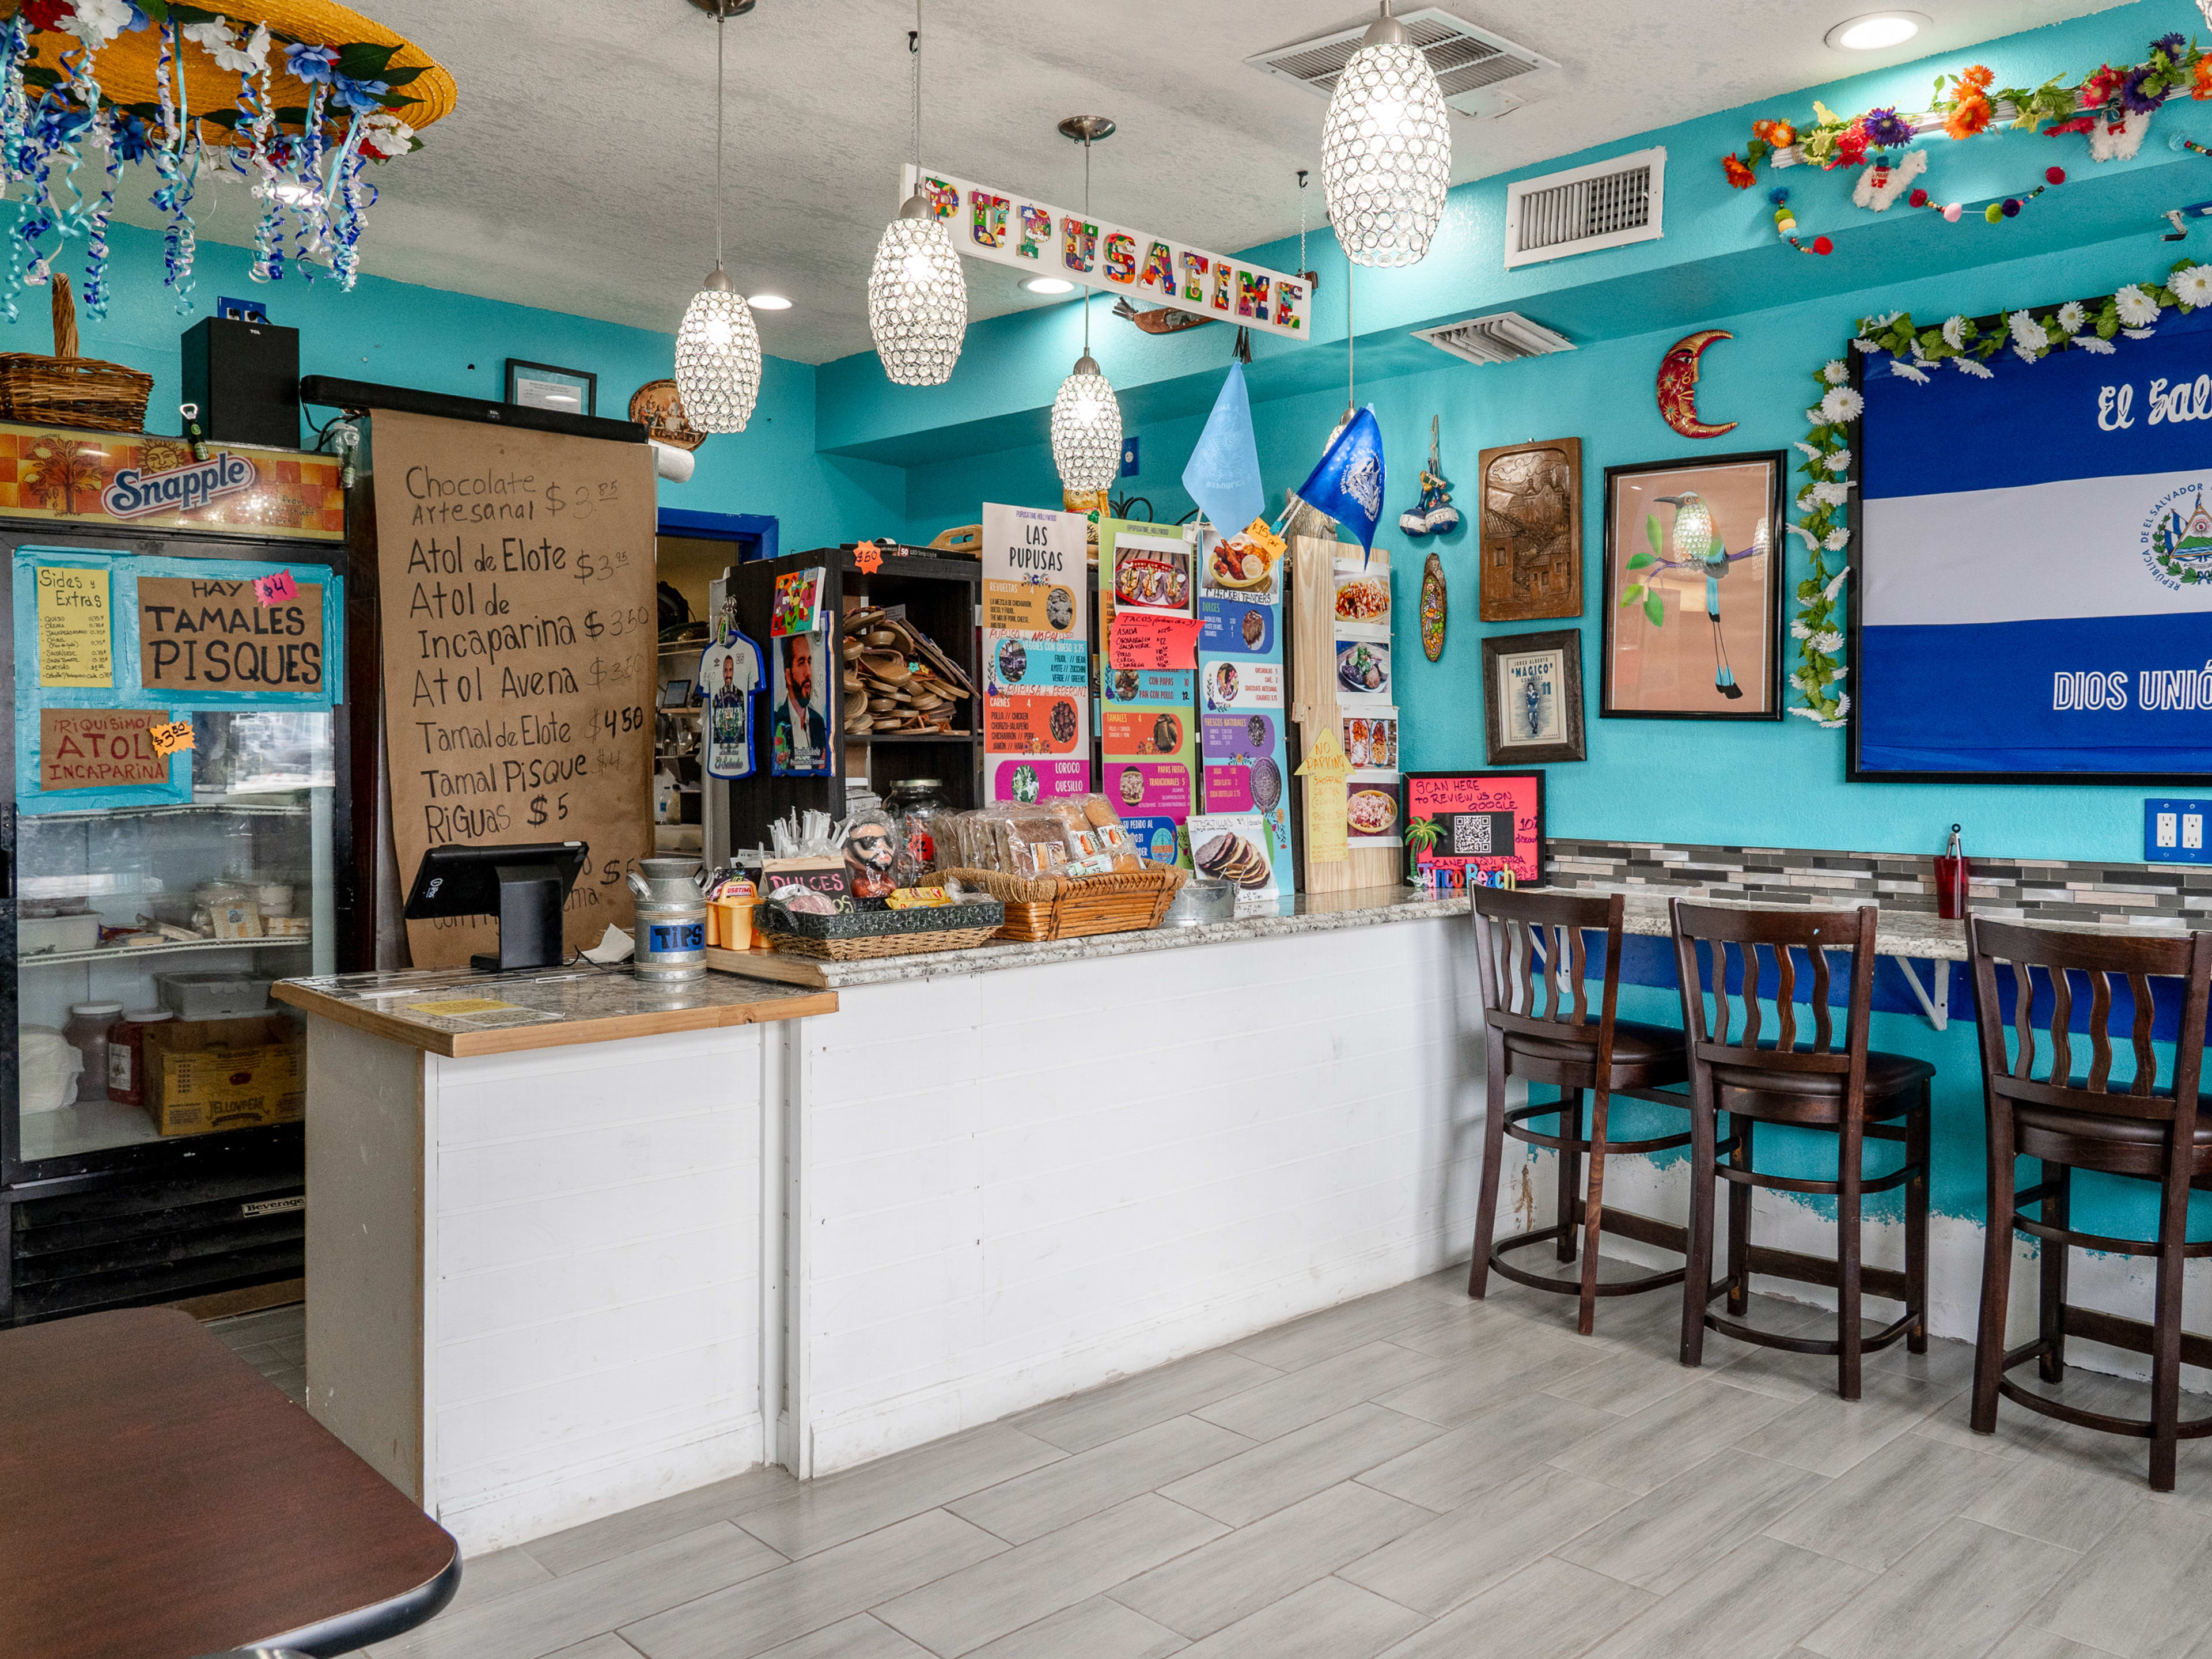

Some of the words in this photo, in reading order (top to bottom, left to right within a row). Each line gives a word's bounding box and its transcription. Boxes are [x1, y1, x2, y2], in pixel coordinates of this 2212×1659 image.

[924, 176, 1301, 329] PUPUSATIME
[2098, 384, 2135, 431] El
[2148, 374, 2212, 425] Sal
[111, 451, 247, 512] Snapple
[406, 465, 536, 499] Chocolate
[282, 495, 305, 505] from
[2149, 483, 2203, 516] SALVADOR
[290, 507, 316, 516] stuff
[412, 501, 534, 526] Artesanal
[2143, 518, 2153, 528] EL
[1027, 525, 1047, 546] LAS
[2141, 532, 2149, 543] DE
[408, 536, 463, 574] Atol
[474, 543, 497, 572] de
[502, 537, 566, 572] Elote
[1010, 547, 1063, 571] PUPUSAS
[2142, 549, 2181, 591] REPÚBLICA
[40, 569, 82, 588] Sides
[90, 580, 96, 589] y
[191, 581, 244, 599] HAY
[263, 577, 286, 600] $4
[989, 581, 1018, 593] REVUELTAS
[1030, 586, 1034, 595] 4
[56, 590, 102, 608] Extras
[410, 581, 475, 619] Atol
[485, 582, 510, 616] de
[1202, 601, 1220, 612] DULCES
[144, 605, 305, 637] TAMALES
[1123, 615, 1153, 623] TACOS
[1032, 631, 1058, 642] NOPAL
[1117, 627, 1138, 636] ASADA
[418, 615, 576, 665] Incaparina
[1023, 641, 1043, 651] VEGGIES
[1044, 642, 1055, 652] CON
[1056, 643, 1072, 653] QUESO
[1074, 643, 1084, 653] 3.75
[148, 639, 321, 685] PISQUES
[736, 653, 745, 664] ES
[1051, 665, 1063, 673] AYOTE
[1070, 665, 1086, 673] ZUCCHINI
[1052, 674, 1064, 682] VERDE
[1149, 676, 1158, 685] CON
[1160, 677, 1174, 686] PAPAS
[1184, 678, 1190, 687] 10
[414, 666, 482, 707] Atol
[501, 666, 579, 699] Avena
[1006, 684, 1041, 696] PUPUSA
[1052, 685, 1088, 697] PEPERONI
[1541, 681, 1551, 695] 11
[2053, 671, 2128, 711] DIOS
[1139, 690, 1149, 699] PAN
[1150, 690, 1160, 699] CON
[1161, 690, 1175, 700] POLLO
[990, 698, 1010, 707] CARNES
[1027, 698, 1031, 708] 4
[1012, 712, 1029, 720] CHICKEN
[1107, 713, 1127, 723] TAMALES
[1138, 714, 1142, 723] 4
[1205, 718, 1223, 726] FRESCOS
[1224, 718, 1247, 727] NATURALES
[416, 719, 492, 754] Tamal
[497, 721, 518, 748] de
[521, 711, 571, 747] Elote
[56, 733, 151, 760] ATOL
[1014, 742, 1024, 750] HAM
[1315, 741, 1331, 755] NO
[1055, 762, 1080, 774] LOROCO
[1158, 765, 1171, 774] PAPAS
[1172, 765, 1185, 774] FRITAS
[1305, 753, 1344, 772] PARKING
[421, 763, 497, 798] Tamal
[1149, 778, 1180, 786] TRADICIONALES
[1416, 781, 1449, 795] SCAN
[1453, 779, 1480, 791] HERE
[1431, 793, 1473, 805] REVIEW
[1493, 791, 1512, 800] ON
[1468, 801, 1518, 812] GOOGLE
[1147, 819, 1154, 828] AL
[1192, 817, 1233, 828] TORTILLAS
[1500, 855, 1526, 865] PARA
[1465, 863, 1516, 890] Beach
[247, 1198, 305, 1211] Beverage
